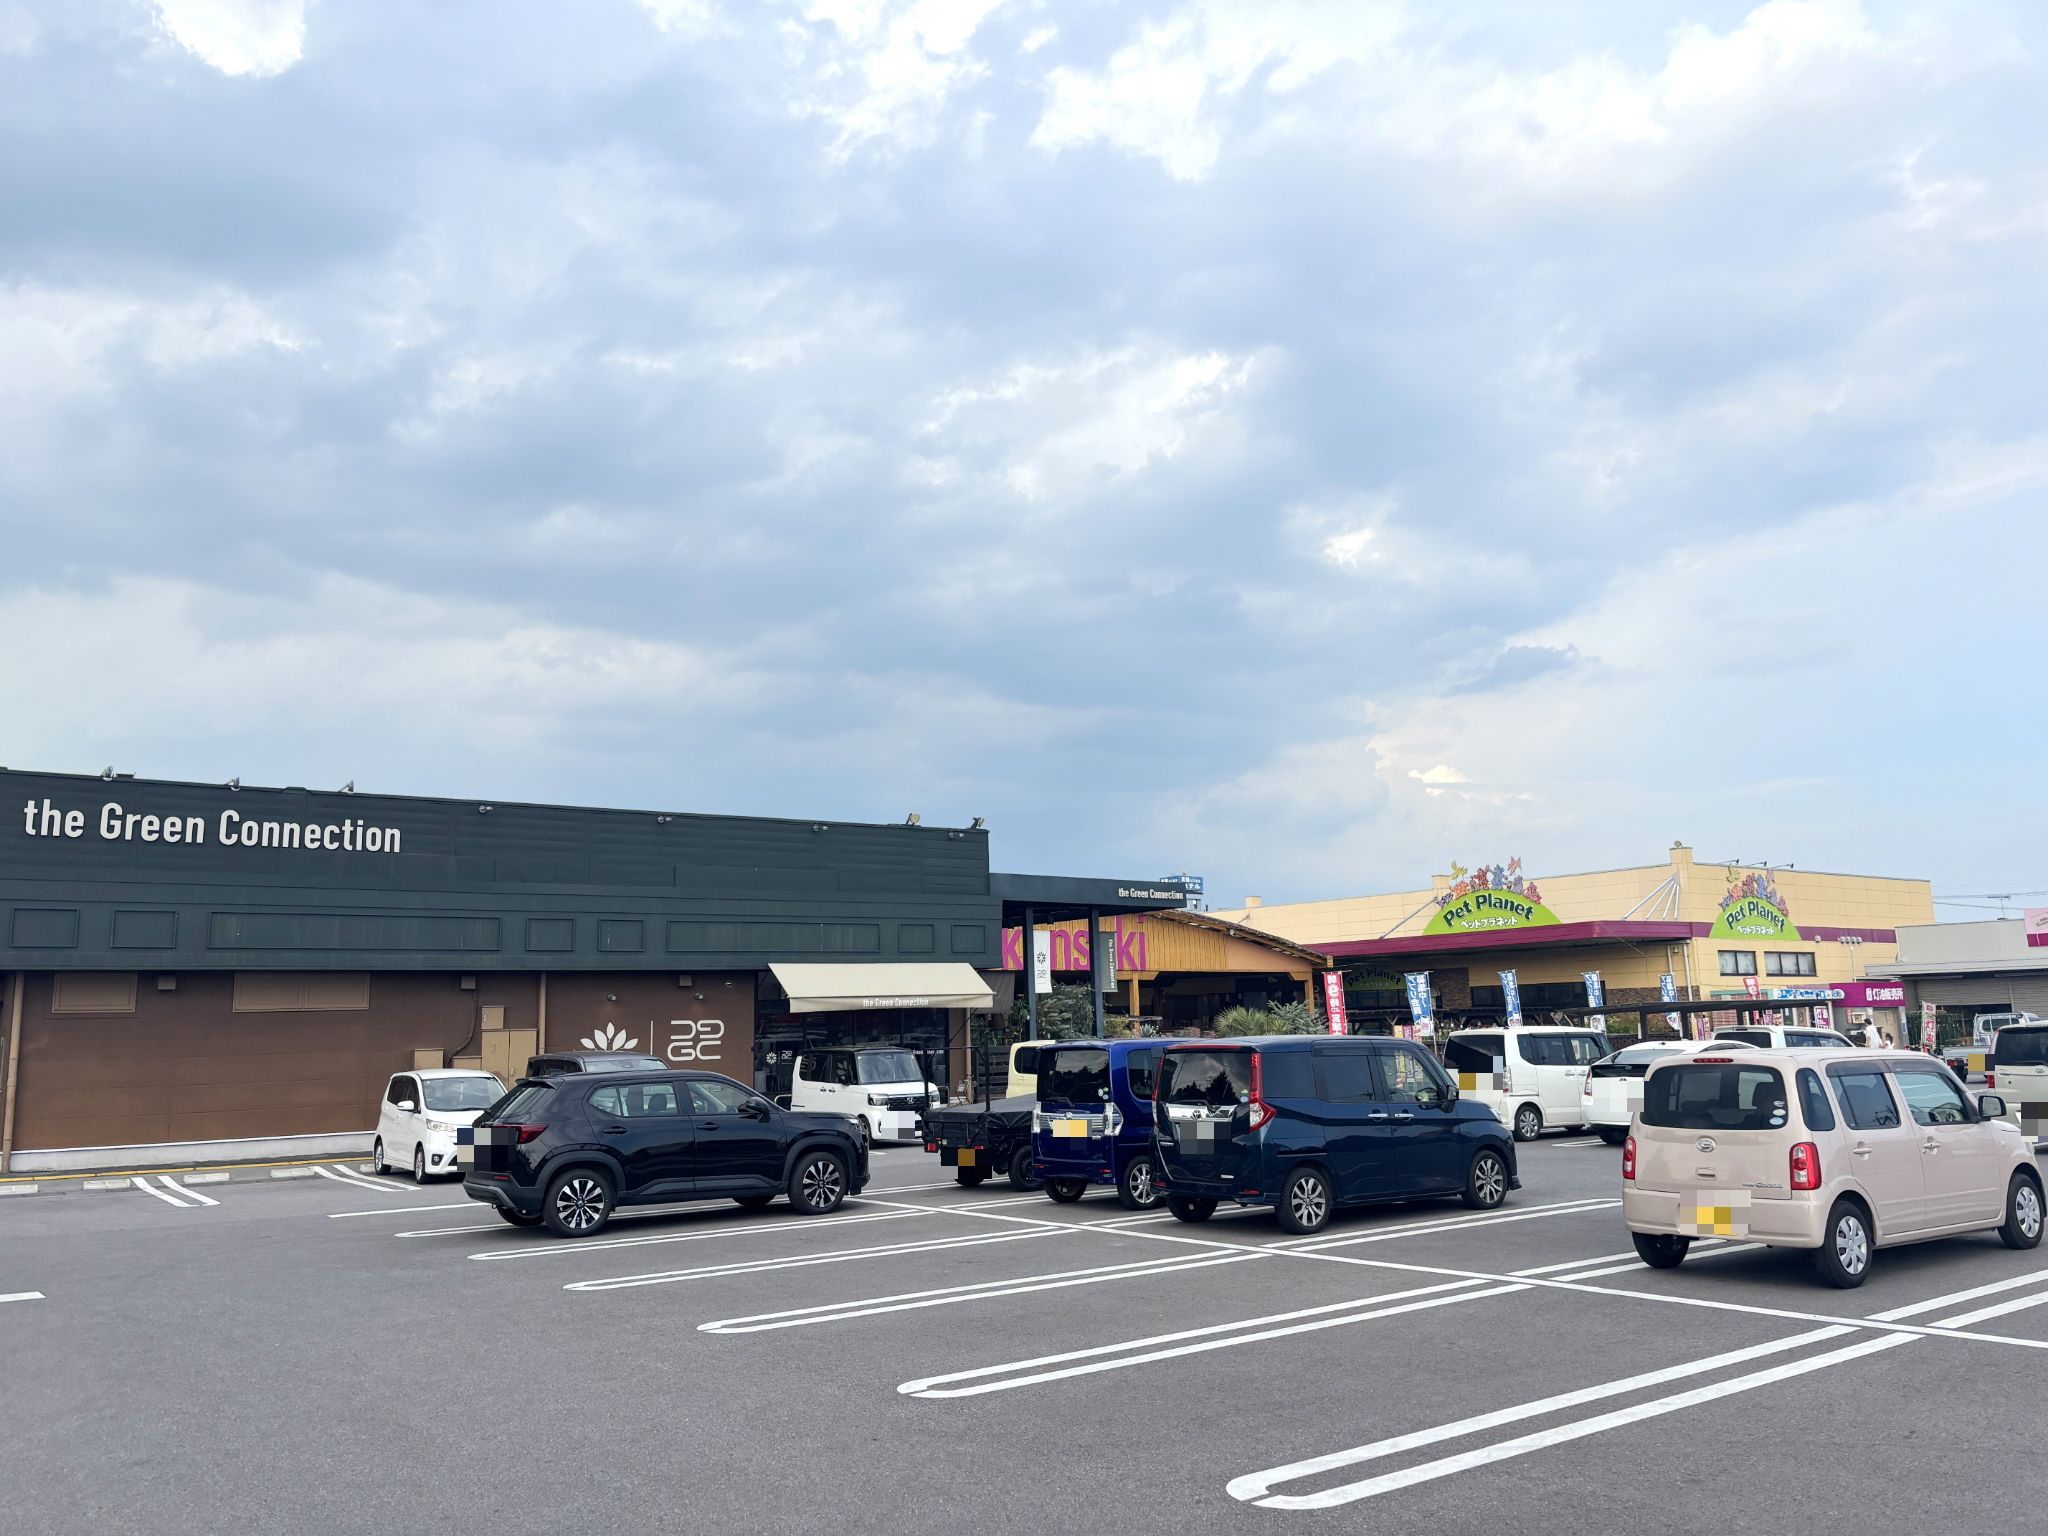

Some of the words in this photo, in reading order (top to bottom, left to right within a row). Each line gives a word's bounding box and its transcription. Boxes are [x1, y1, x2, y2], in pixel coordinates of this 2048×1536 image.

[24, 799, 85, 838] the
[99, 802, 206, 844] Green
[218, 809, 401, 854] Connection
[1118, 887, 1129, 898] the
[1129, 888, 1149, 899] Green
[1149, 889, 1184, 900] Connection
[1443, 900, 1473, 928] Pet
[1475, 893, 1535, 921] Planet
[1726, 904, 1747, 931] Pet
[1747, 900, 1786, 933] Planet
[863, 998, 873, 1007] the
[875, 998, 894, 1007] Green
[895, 997, 929, 1006] Connection
